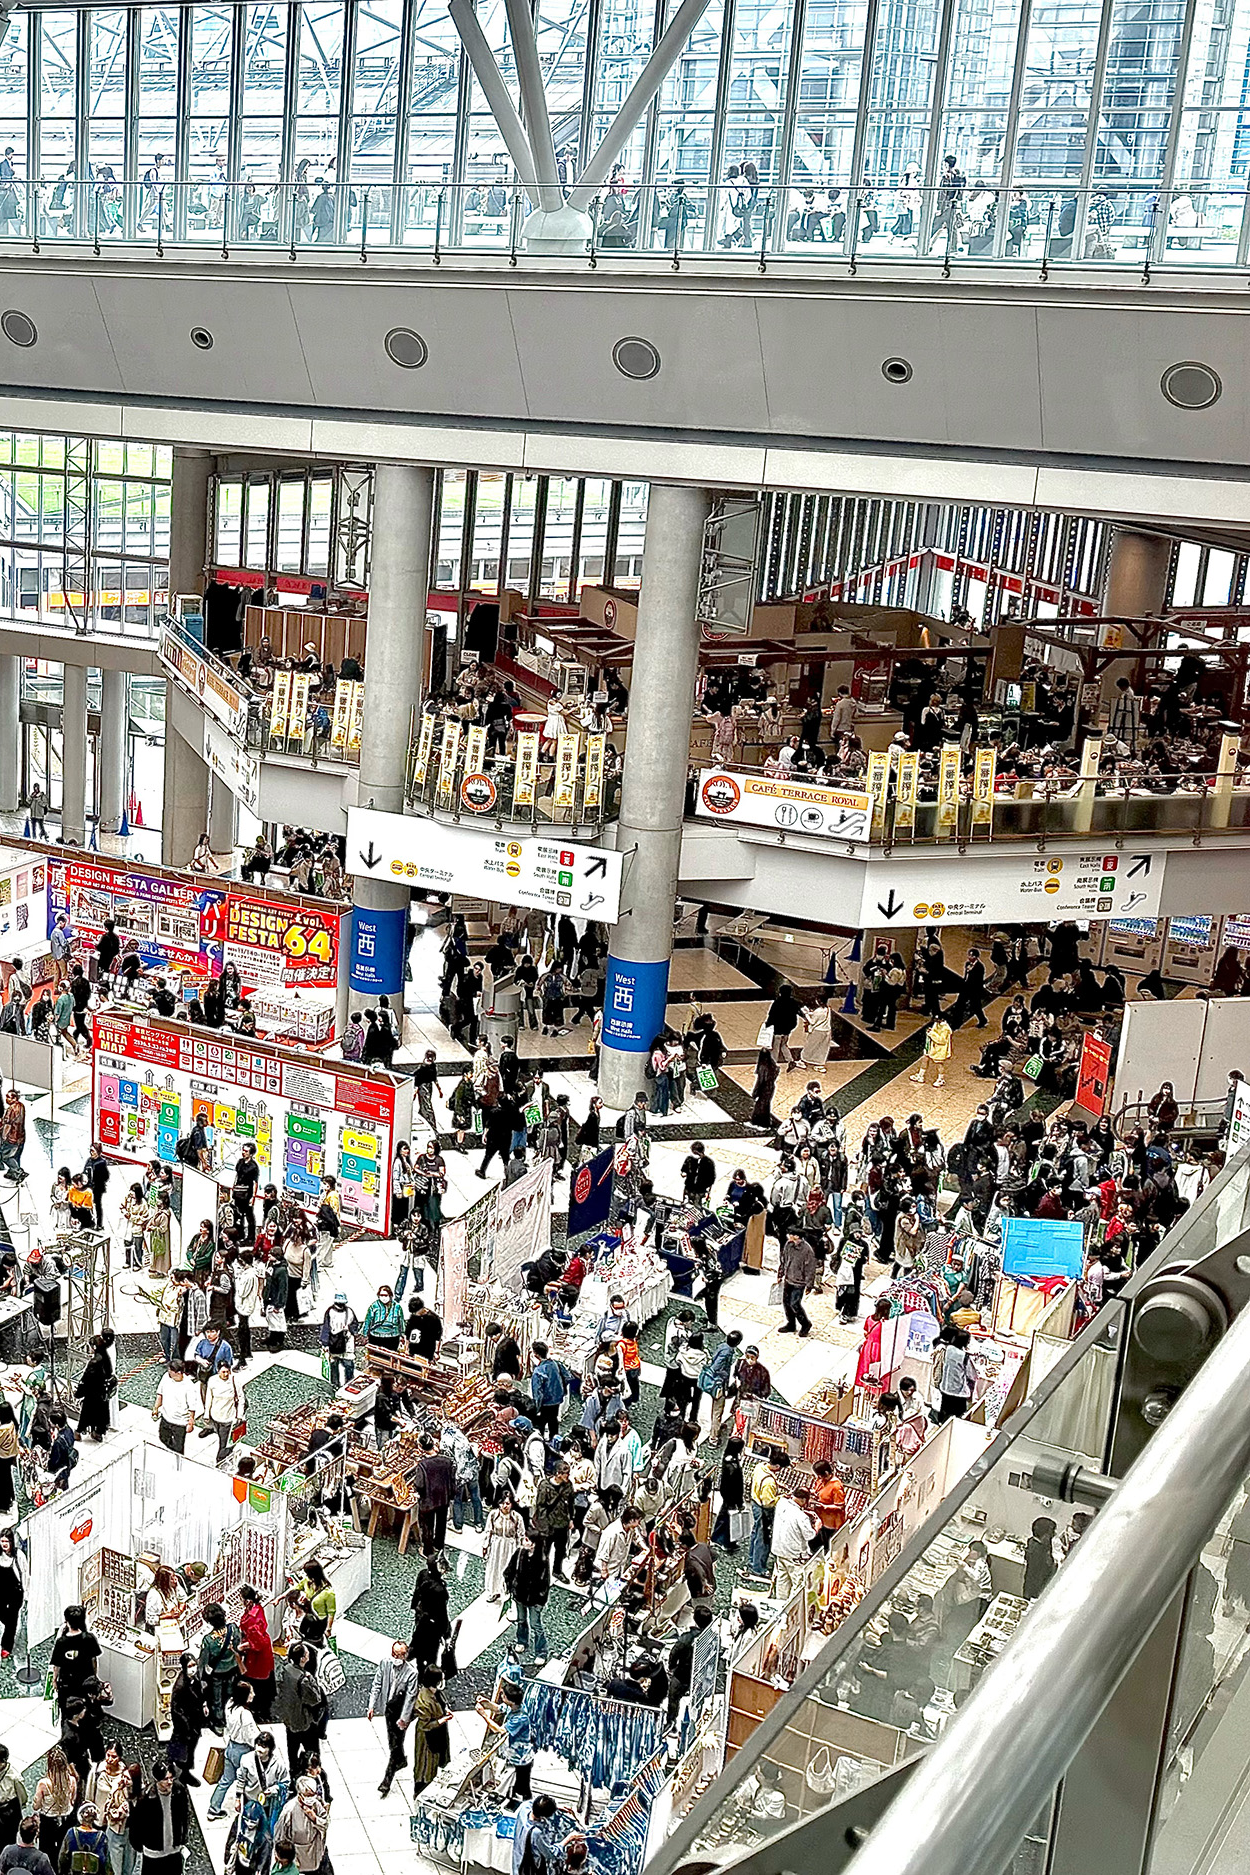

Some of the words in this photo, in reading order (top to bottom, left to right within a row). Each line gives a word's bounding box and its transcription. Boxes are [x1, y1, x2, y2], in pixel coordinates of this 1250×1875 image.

[751, 783, 777, 795] CAFÉ
[780, 787, 828, 803] TERRACE
[831, 795, 860, 807] ROYAL
[70, 865, 110, 883] DESIGN
[113, 874, 148, 891] FESTA
[150, 883, 203, 901] GALLERY
[230, 908, 288, 933] DESIGN
[302, 917, 322, 928] vol.
[358, 920, 377, 933] West
[229, 923, 280, 949] FESTA
[283, 925, 333, 963] 64
[357, 932, 376, 957] 西
[615, 973, 636, 986] West
[613, 985, 634, 1012] 西
[98, 1029, 128, 1046] AREA
[100, 1040, 126, 1054] MAP
[363, 1121, 374, 1131] 4F
